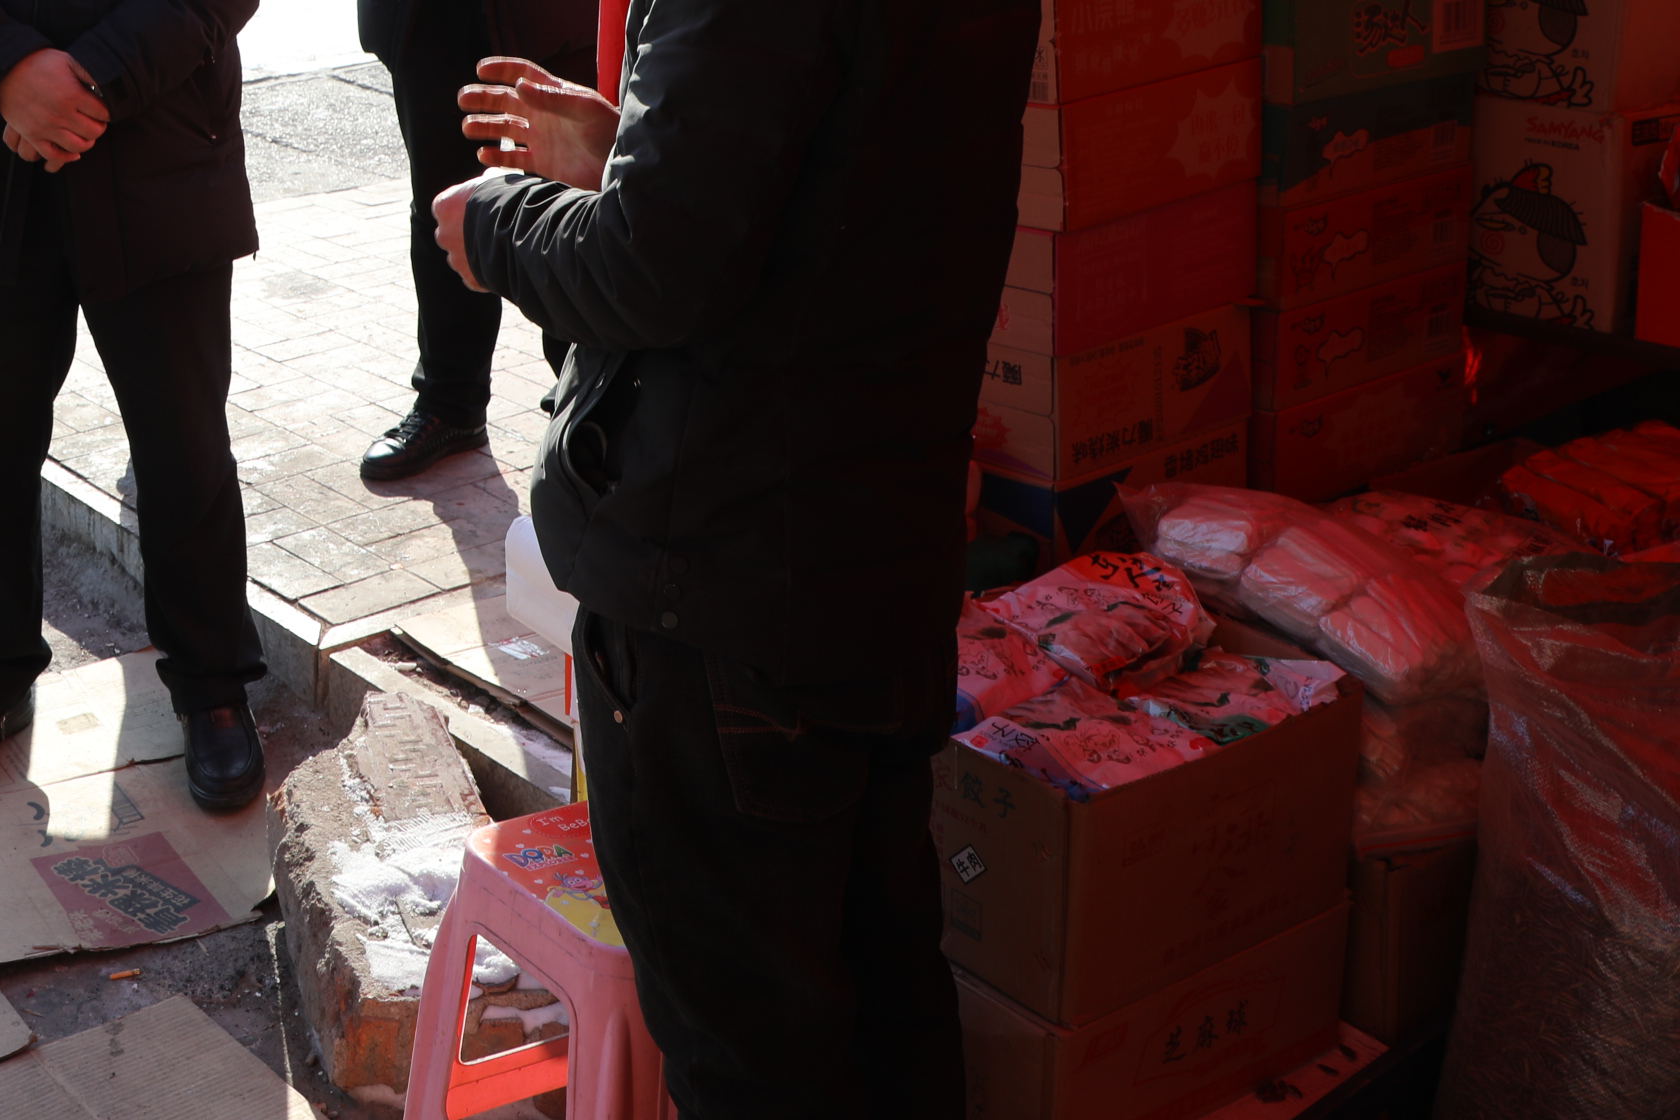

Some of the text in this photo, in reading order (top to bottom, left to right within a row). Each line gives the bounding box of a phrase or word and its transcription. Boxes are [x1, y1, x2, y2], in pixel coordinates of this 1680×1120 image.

[1525, 116, 1605, 144] SAMYANG
[503, 844, 574, 868] DORA
[956, 851, 982, 878] 牛肉
